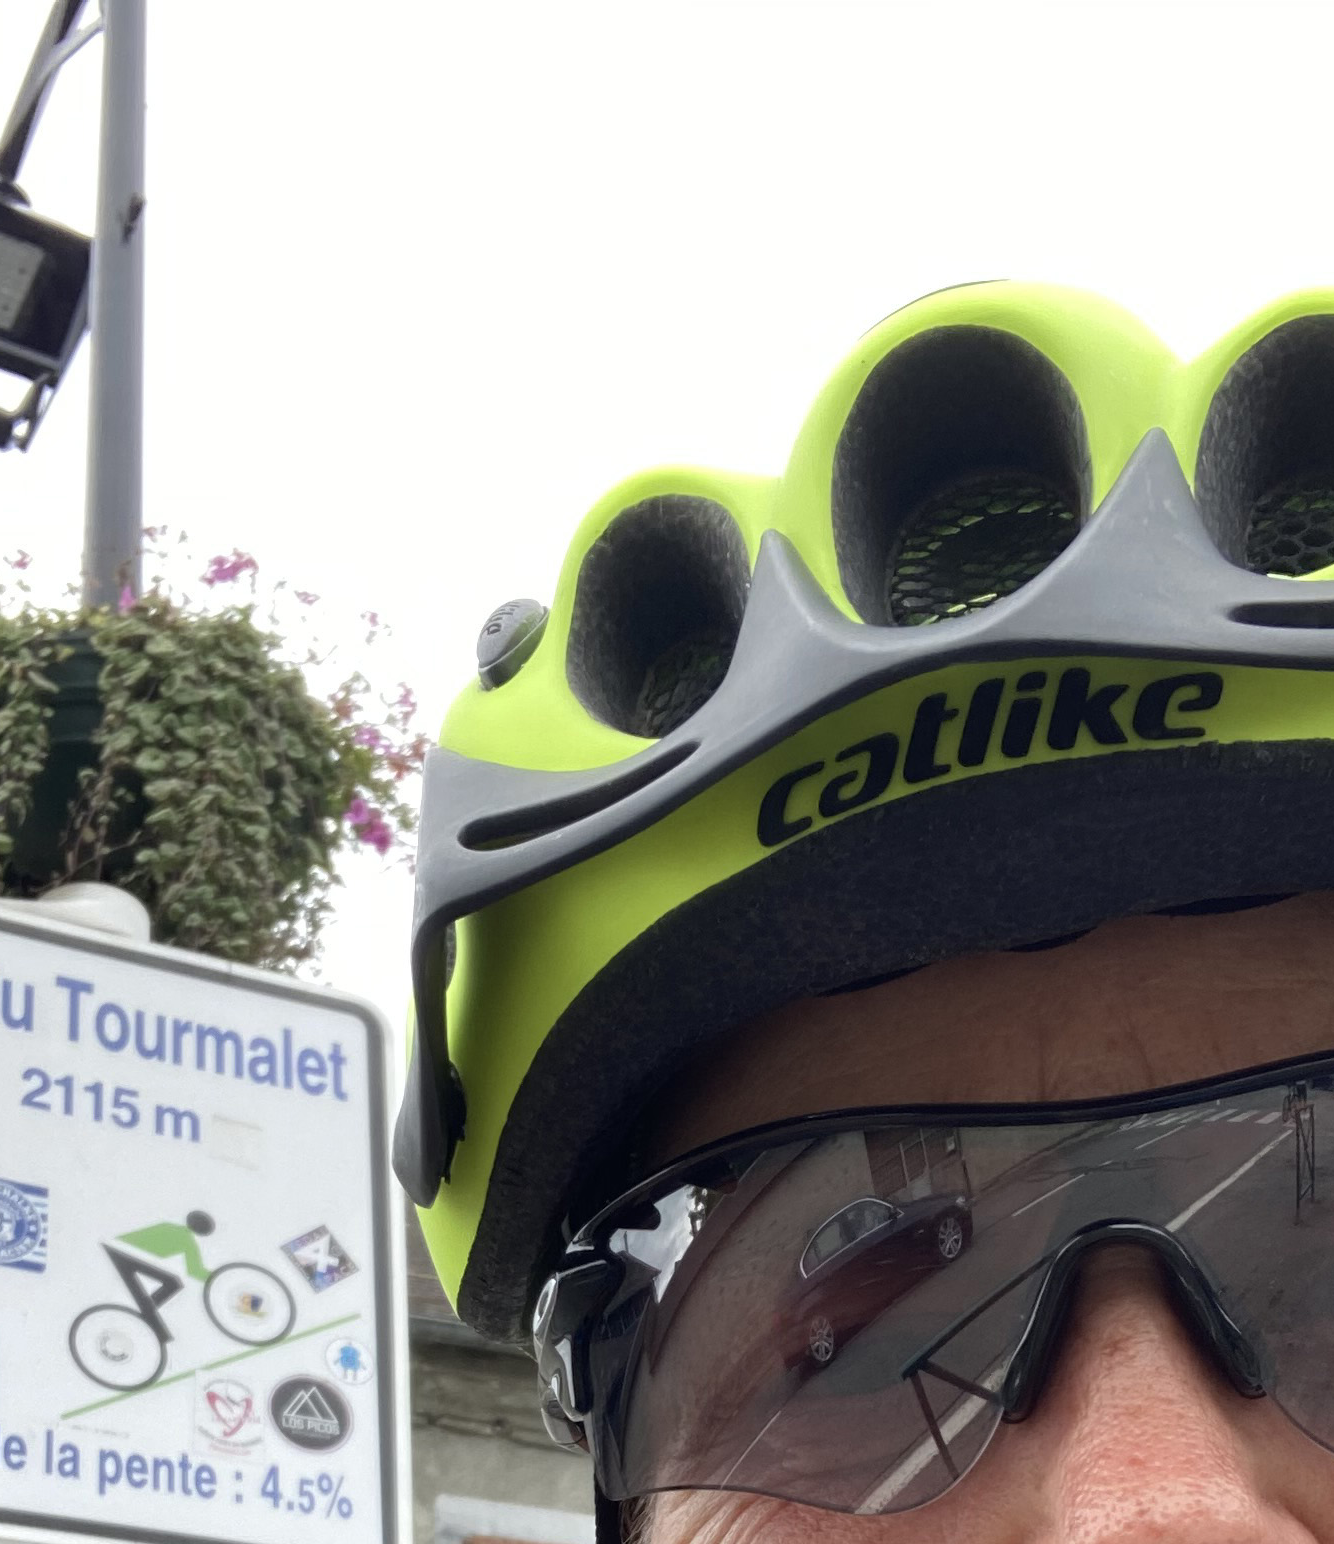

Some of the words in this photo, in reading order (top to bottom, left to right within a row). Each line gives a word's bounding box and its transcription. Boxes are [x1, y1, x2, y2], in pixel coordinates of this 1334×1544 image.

[756, 667, 1224, 847] catlike
[55, 975, 348, 1102] Tourmalet
[21, 1067, 141, 1130] 2115
[154, 1104, 202, 1143] m
[44, 1429, 81, 1480] la
[98, 1449, 218, 1500] pente
[260, 1464, 354, 1520] 4.5%
